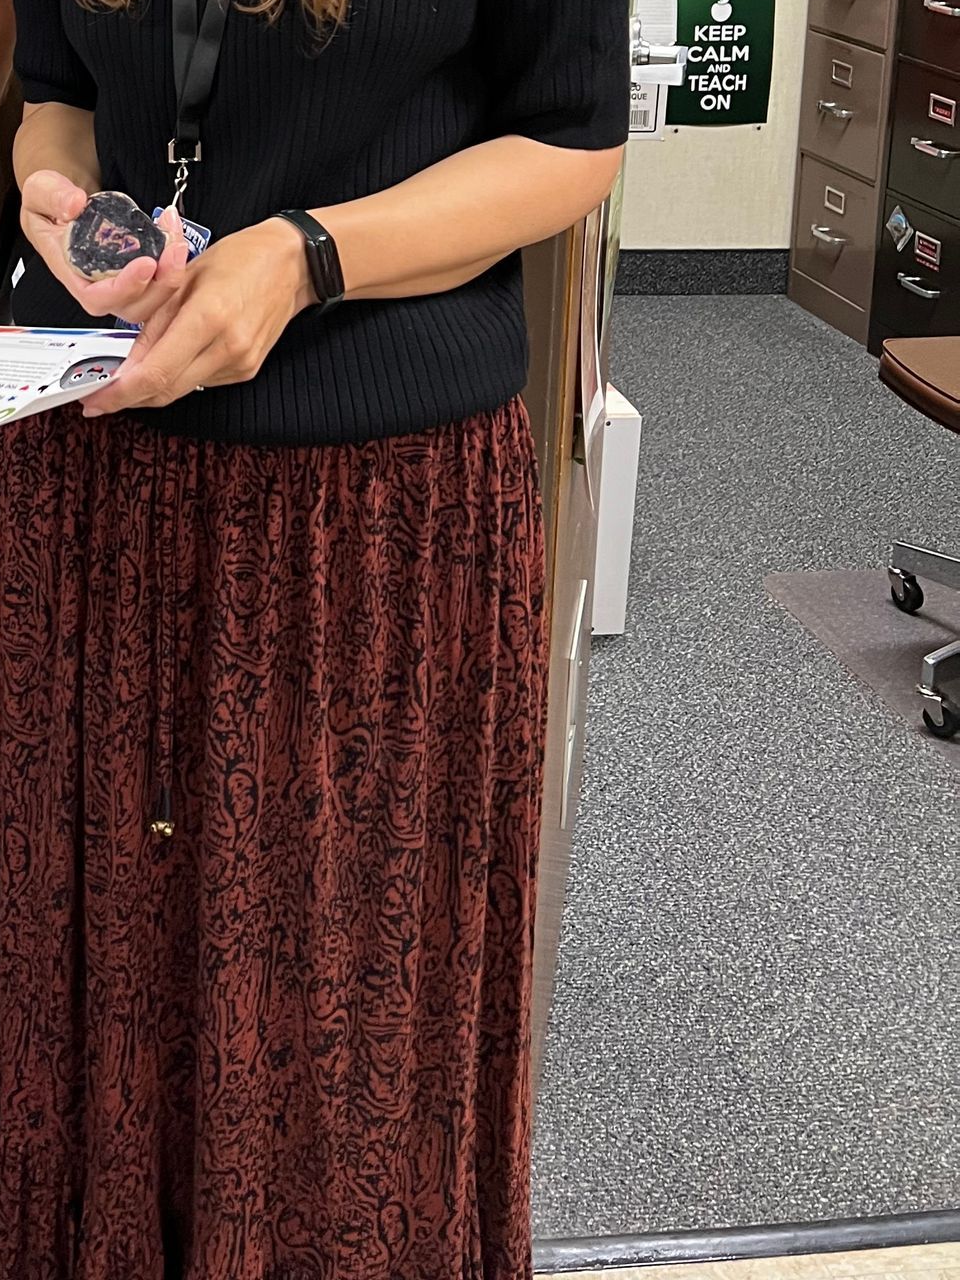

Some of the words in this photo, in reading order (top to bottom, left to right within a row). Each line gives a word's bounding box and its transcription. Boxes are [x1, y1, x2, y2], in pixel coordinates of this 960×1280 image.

[694, 25, 747, 42] KEEP
[687, 45, 750, 63] CALM
[707, 64, 731, 74] AND
[688, 74, 747, 92] TEACH
[700, 94, 732, 111] ON
